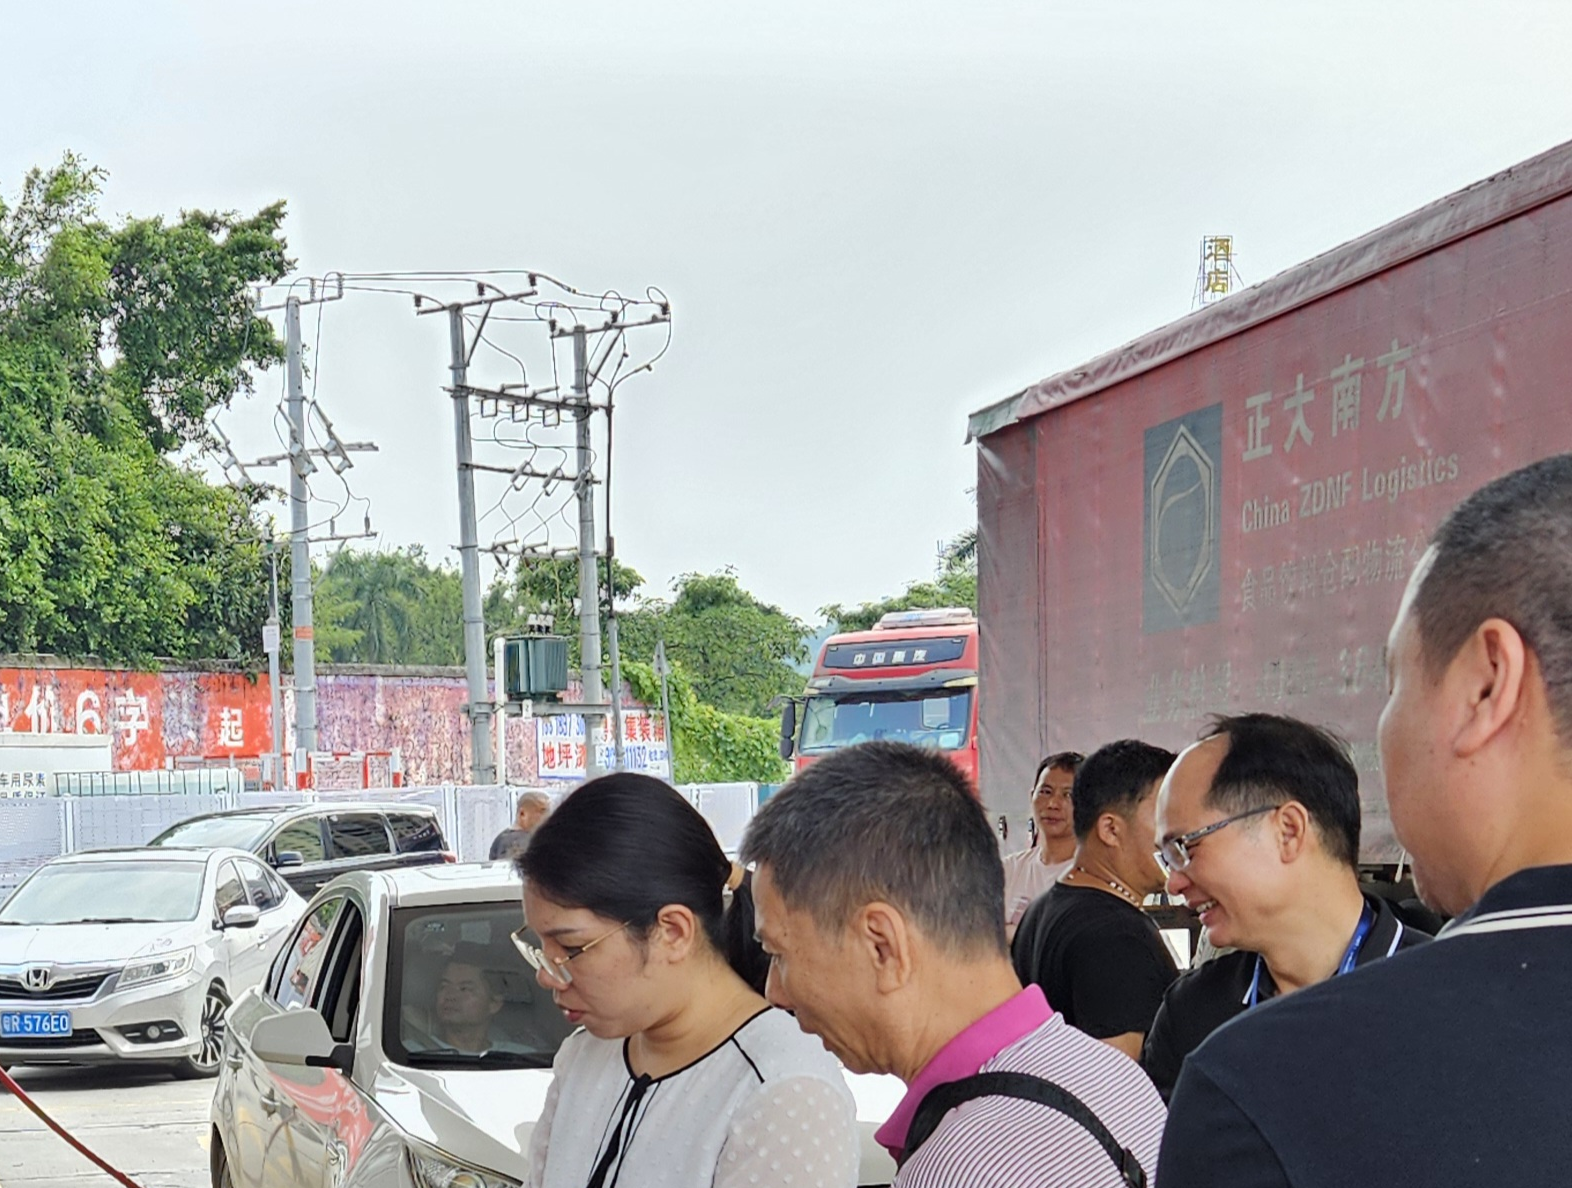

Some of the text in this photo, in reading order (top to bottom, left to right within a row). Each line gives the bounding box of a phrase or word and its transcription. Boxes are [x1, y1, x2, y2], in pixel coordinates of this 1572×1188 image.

[1205, 236, 1230, 294] 酒店
[1242, 338, 1412, 462] 正大南方
[1242, 453, 1460, 534] China ZDNF Logistics
